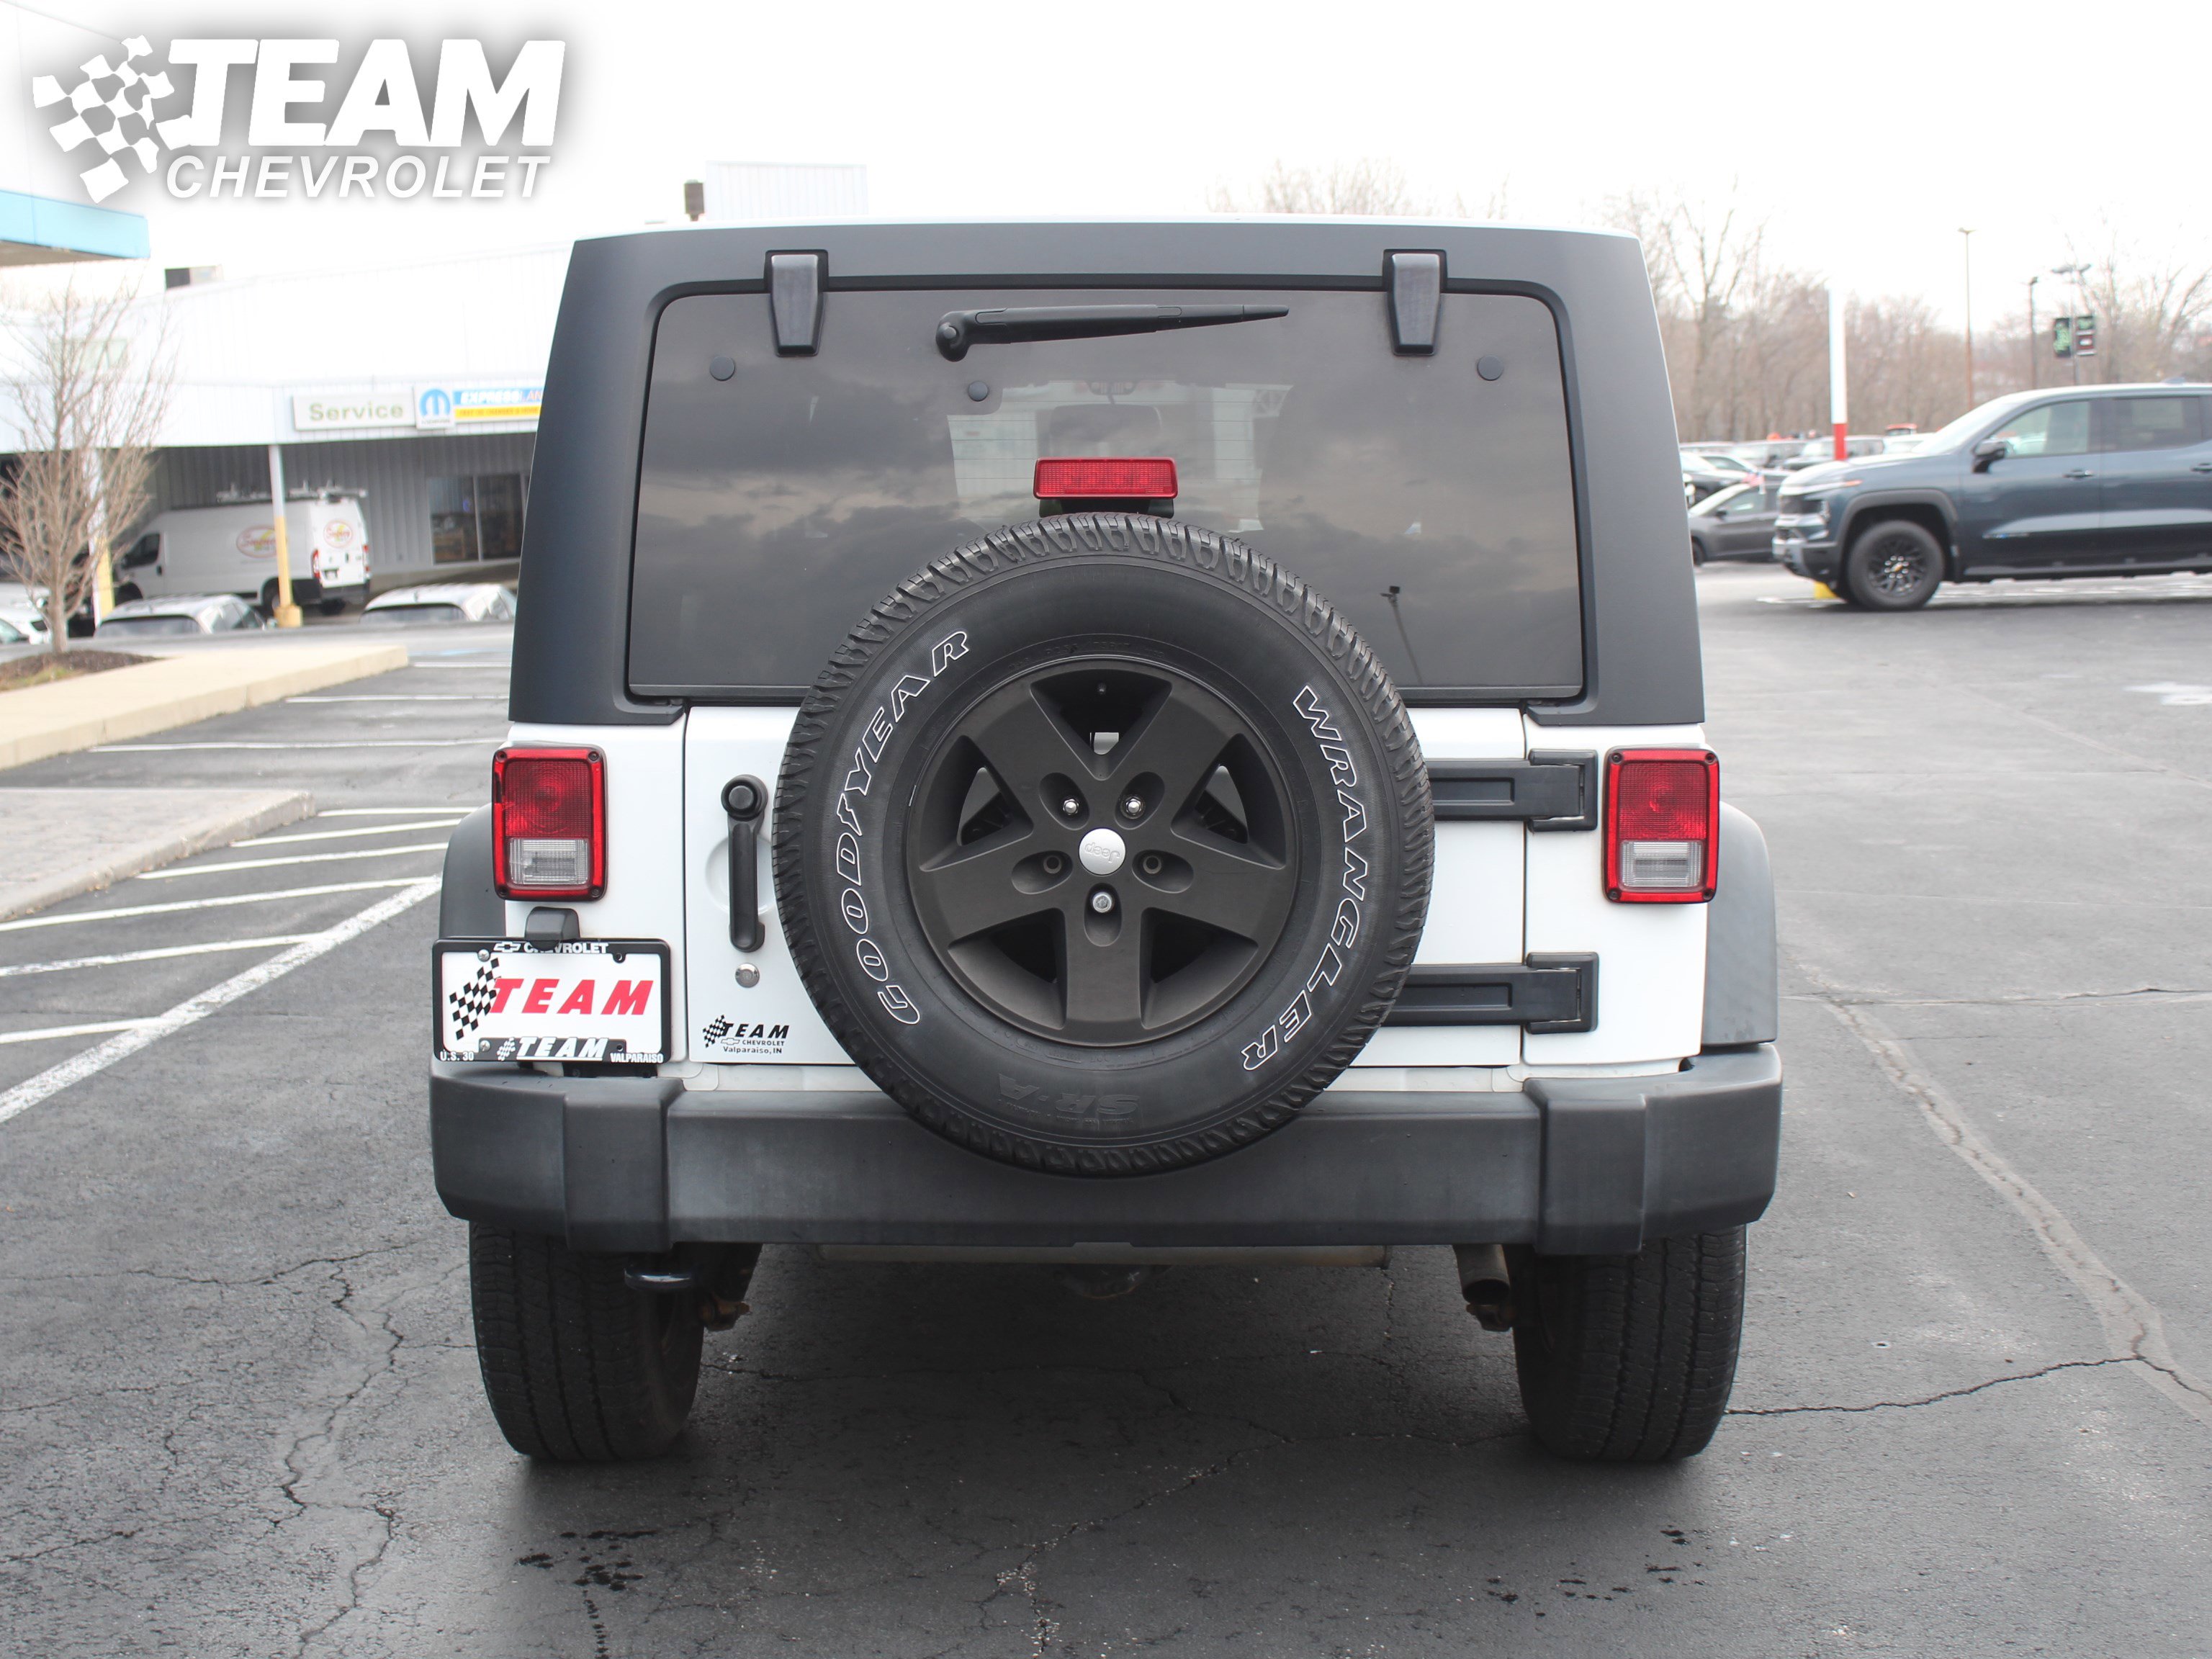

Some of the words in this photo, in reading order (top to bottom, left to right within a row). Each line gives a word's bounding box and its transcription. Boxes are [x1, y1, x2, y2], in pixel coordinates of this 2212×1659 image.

[309, 401, 404, 421] Service
[836, 630, 969, 1025] GOODYEAR
[1084, 842, 1120, 863] Jeep
[1241, 685, 1370, 1071] WRANGLER
[523, 942, 608, 953] CVROLET
[490, 978, 654, 1015] TEAM
[719, 1023, 790, 1038] TEAM
[440, 1051, 460, 1061] U.S.
[462, 1051, 475, 1061] 30
[516, 1036, 610, 1058] TEAM
[610, 1052, 664, 1064] VALPARAISO
